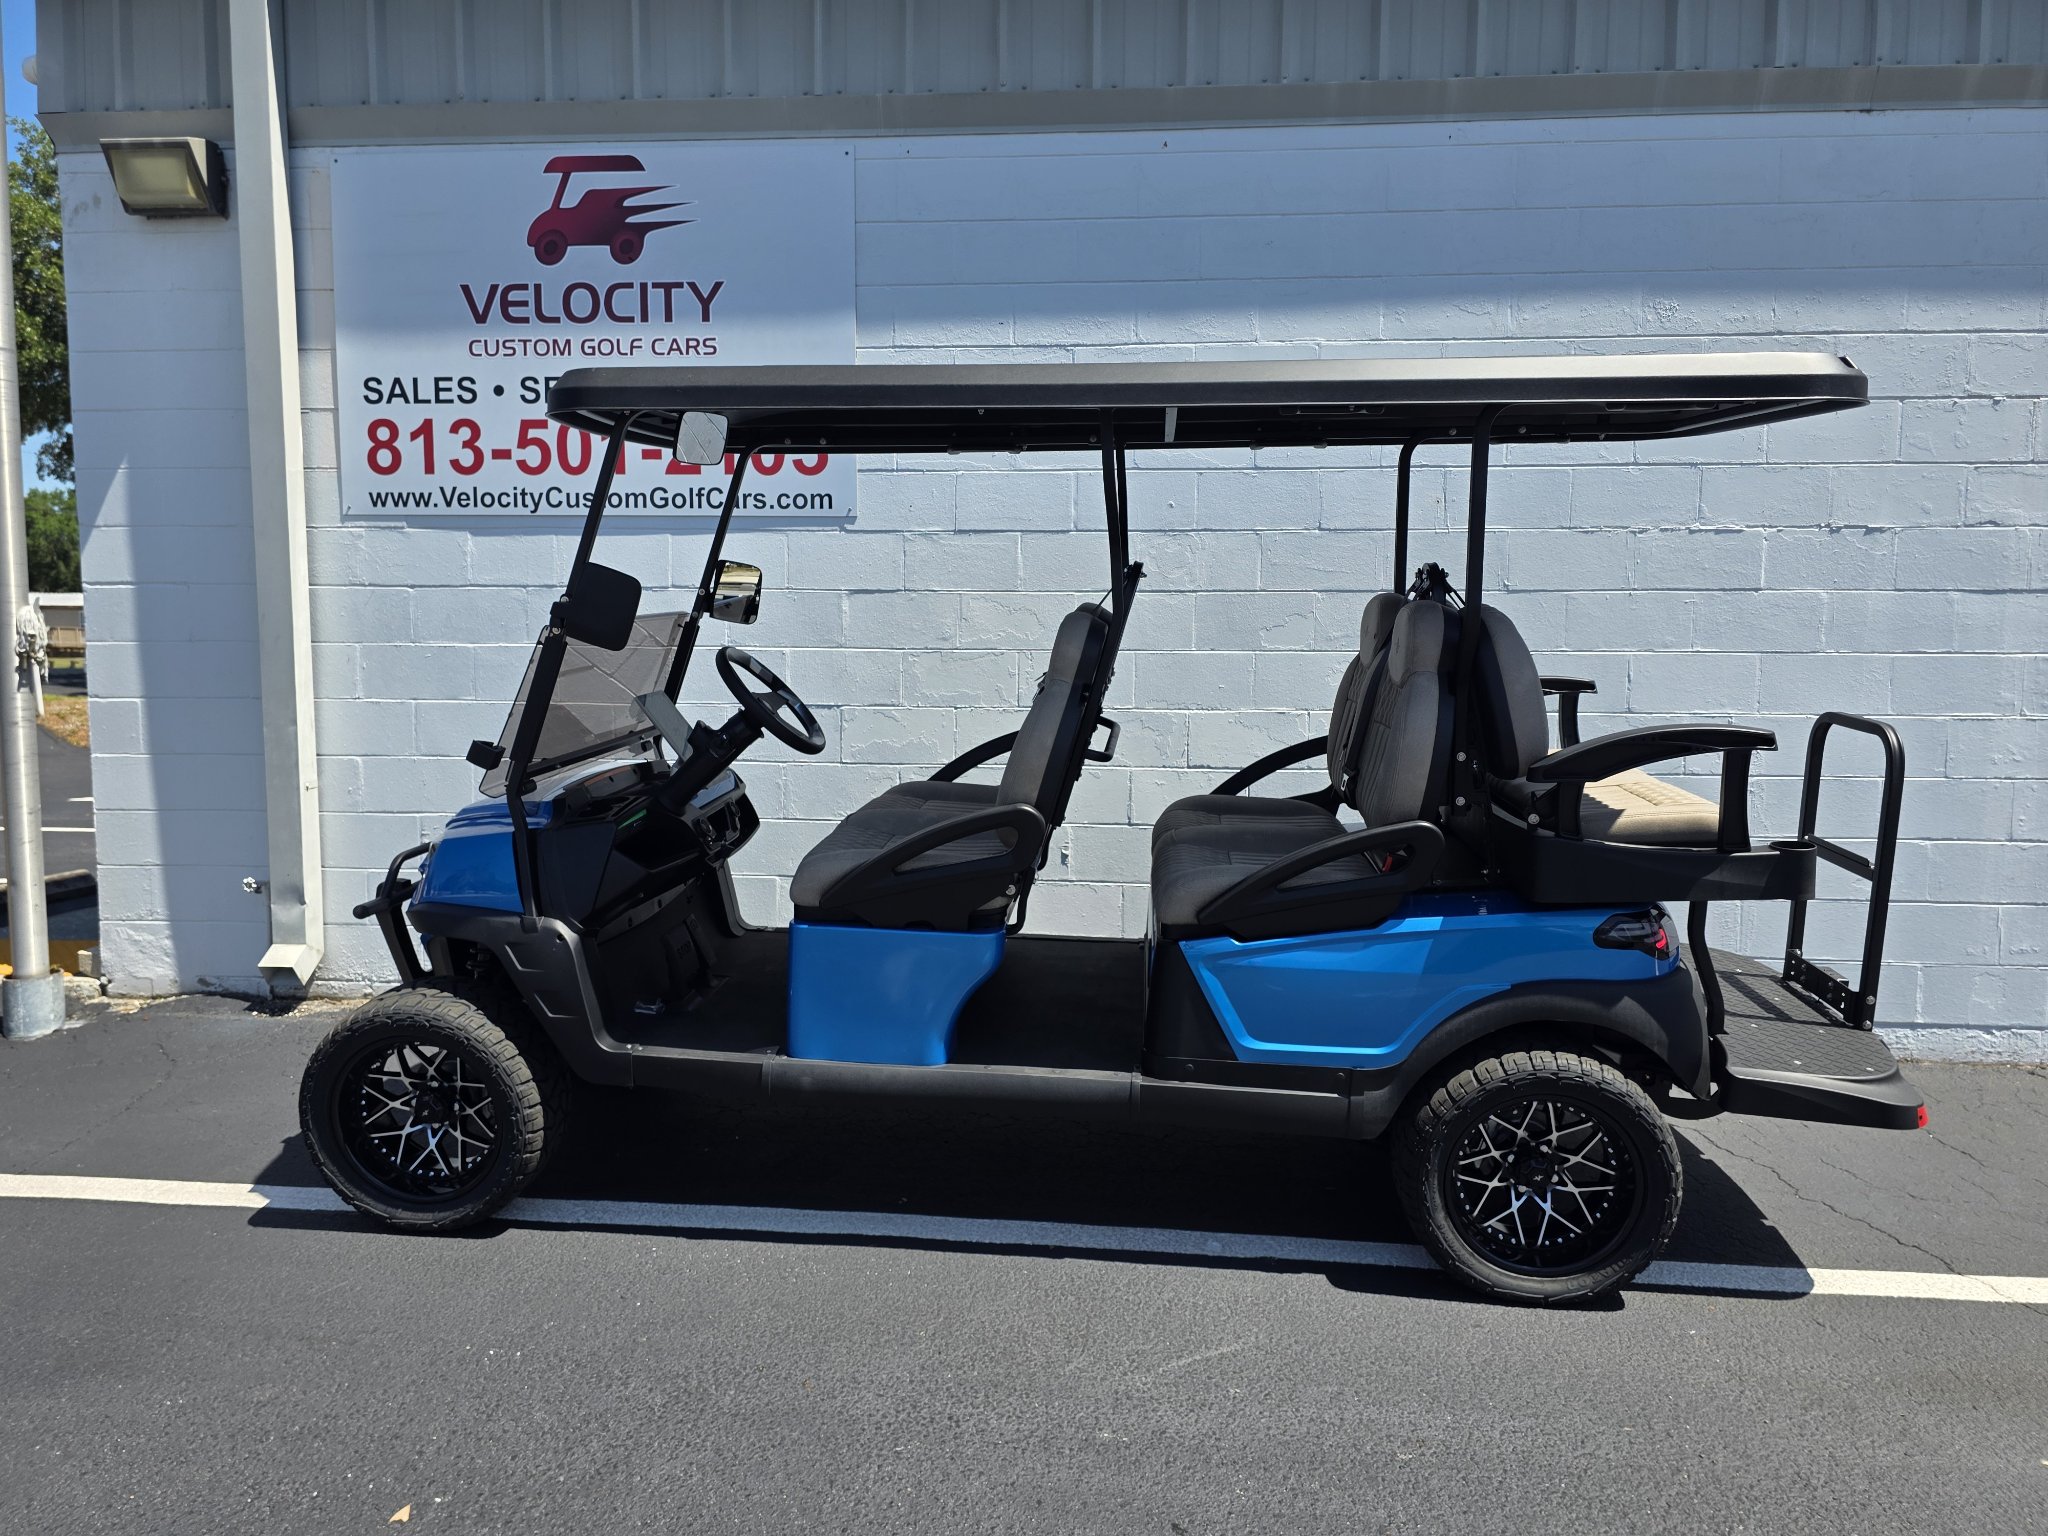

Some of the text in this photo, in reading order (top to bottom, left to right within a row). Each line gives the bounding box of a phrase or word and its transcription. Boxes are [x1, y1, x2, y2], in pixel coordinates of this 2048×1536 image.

[459, 281, 725, 324] VELOCITY
[468, 337, 719, 357] CUSTOM GOLF CARS
[363, 376, 478, 404] SALES
[367, 418, 829, 476] 813-50-
[368, 486, 833, 514] www.VelocityCusomGolfCrs.com
